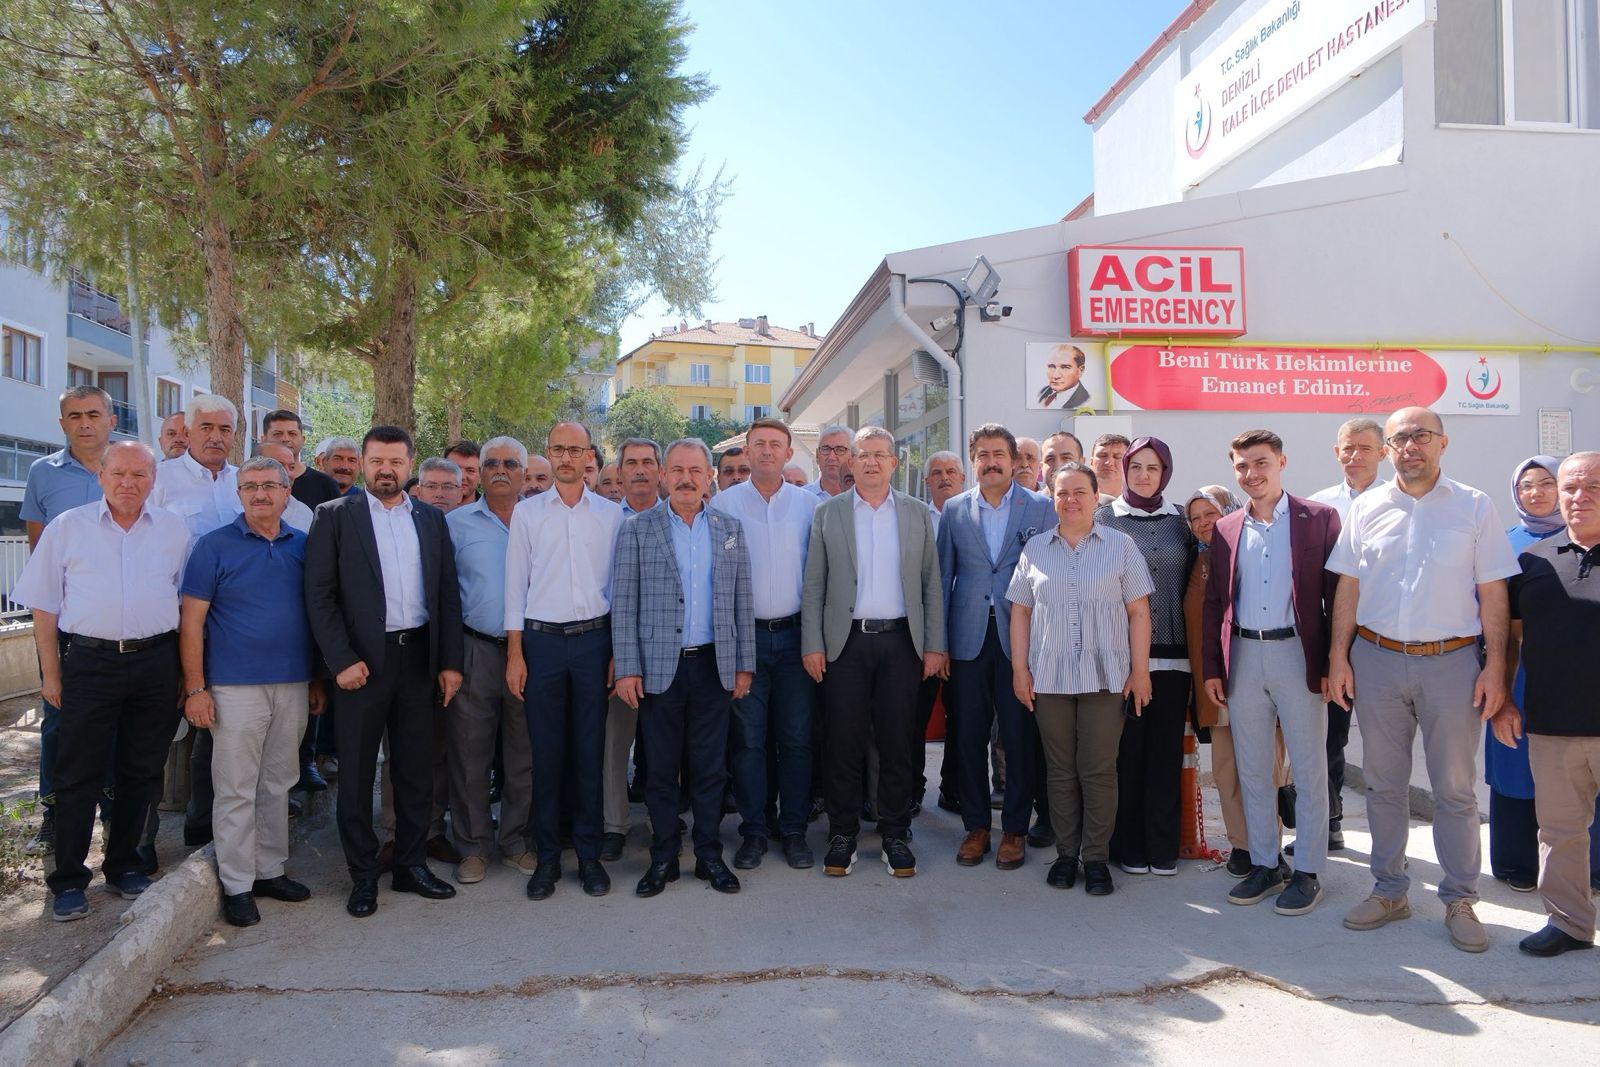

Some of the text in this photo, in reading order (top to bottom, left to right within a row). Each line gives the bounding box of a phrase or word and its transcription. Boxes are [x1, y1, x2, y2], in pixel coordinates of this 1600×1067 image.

[1220, 0, 1301, 76] T.C. Sağlık Bakanlığı
[1221, 57, 1261, 108] DENİZLİ
[1222, 0, 1410, 137] KALE İLÇE DEVLET HASTANES
[1089, 297, 1236, 325] EMERGENCY
[1158, 350, 1413, 373] Beni Türk Hekimlerine
[1200, 376, 1371, 396] Emanet Ediniz.
